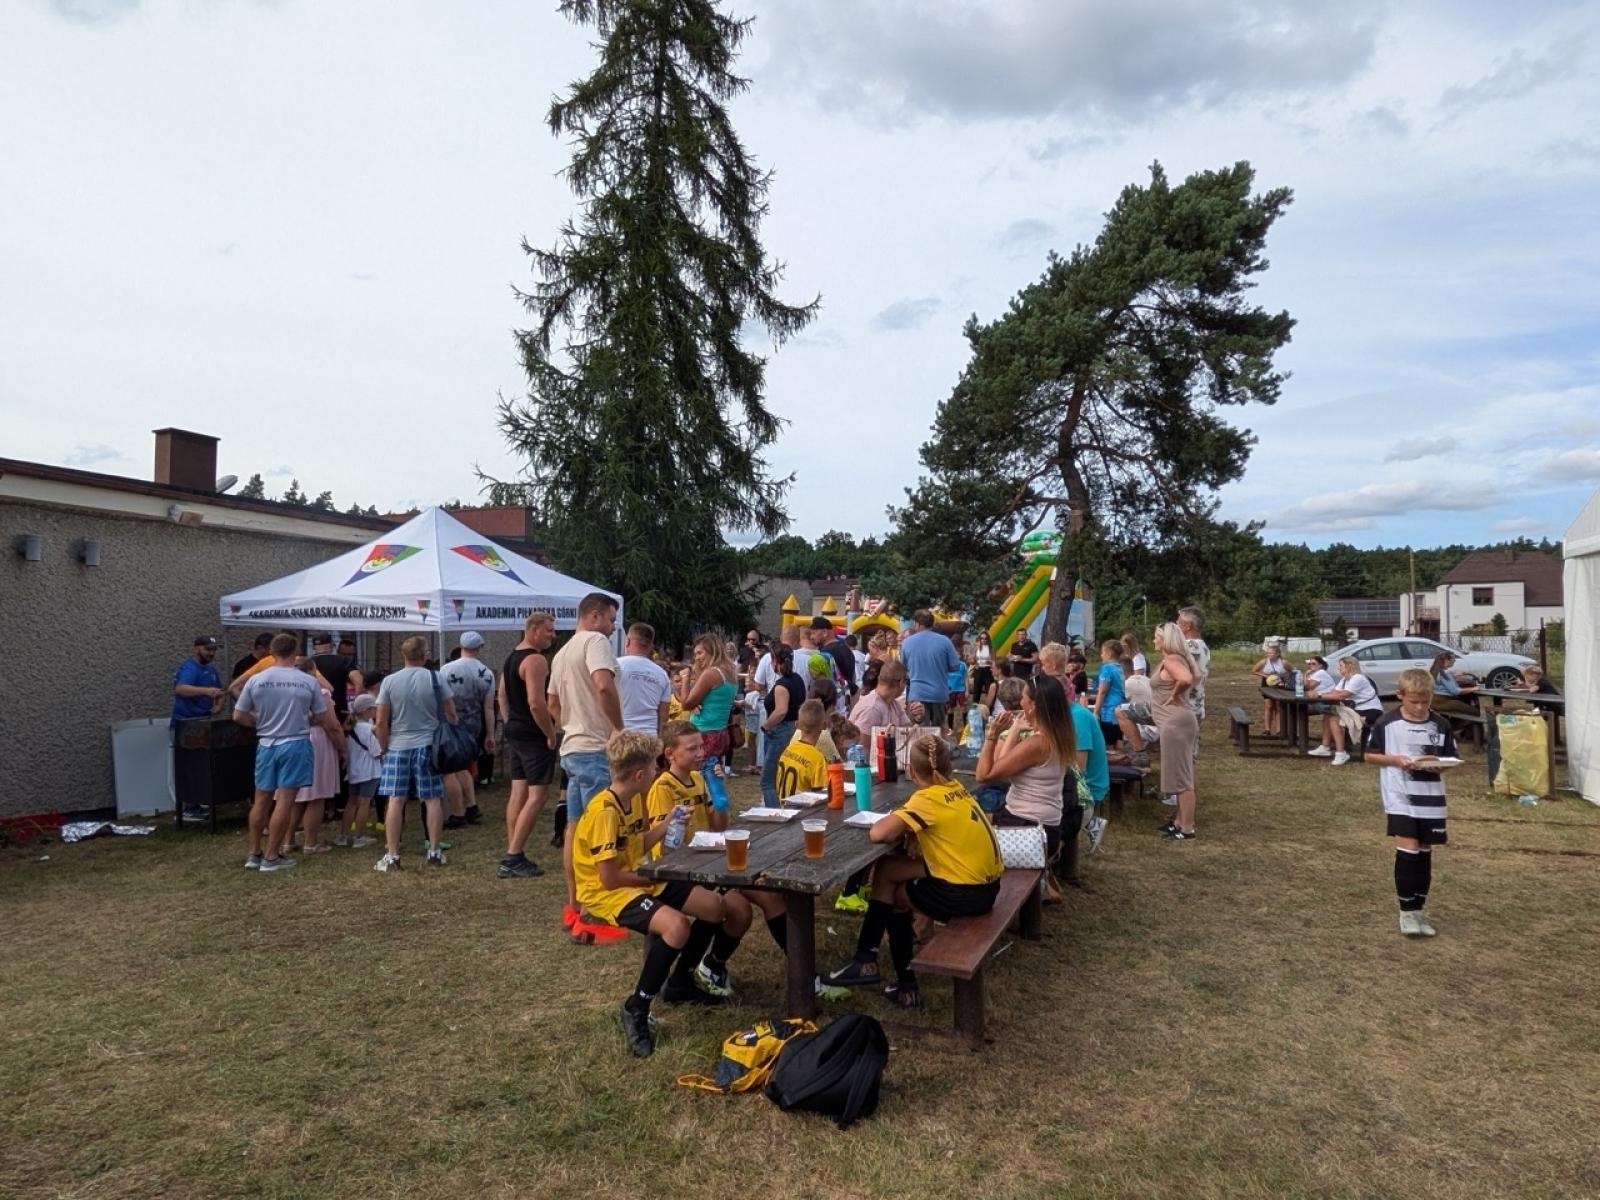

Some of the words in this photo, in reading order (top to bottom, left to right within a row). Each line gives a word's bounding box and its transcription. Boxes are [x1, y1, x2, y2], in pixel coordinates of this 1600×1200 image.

[340, 605, 368, 618] GÓRKI
[476, 606, 515, 619] AKADEMIA
[557, 605, 577, 619] GÓRKI
